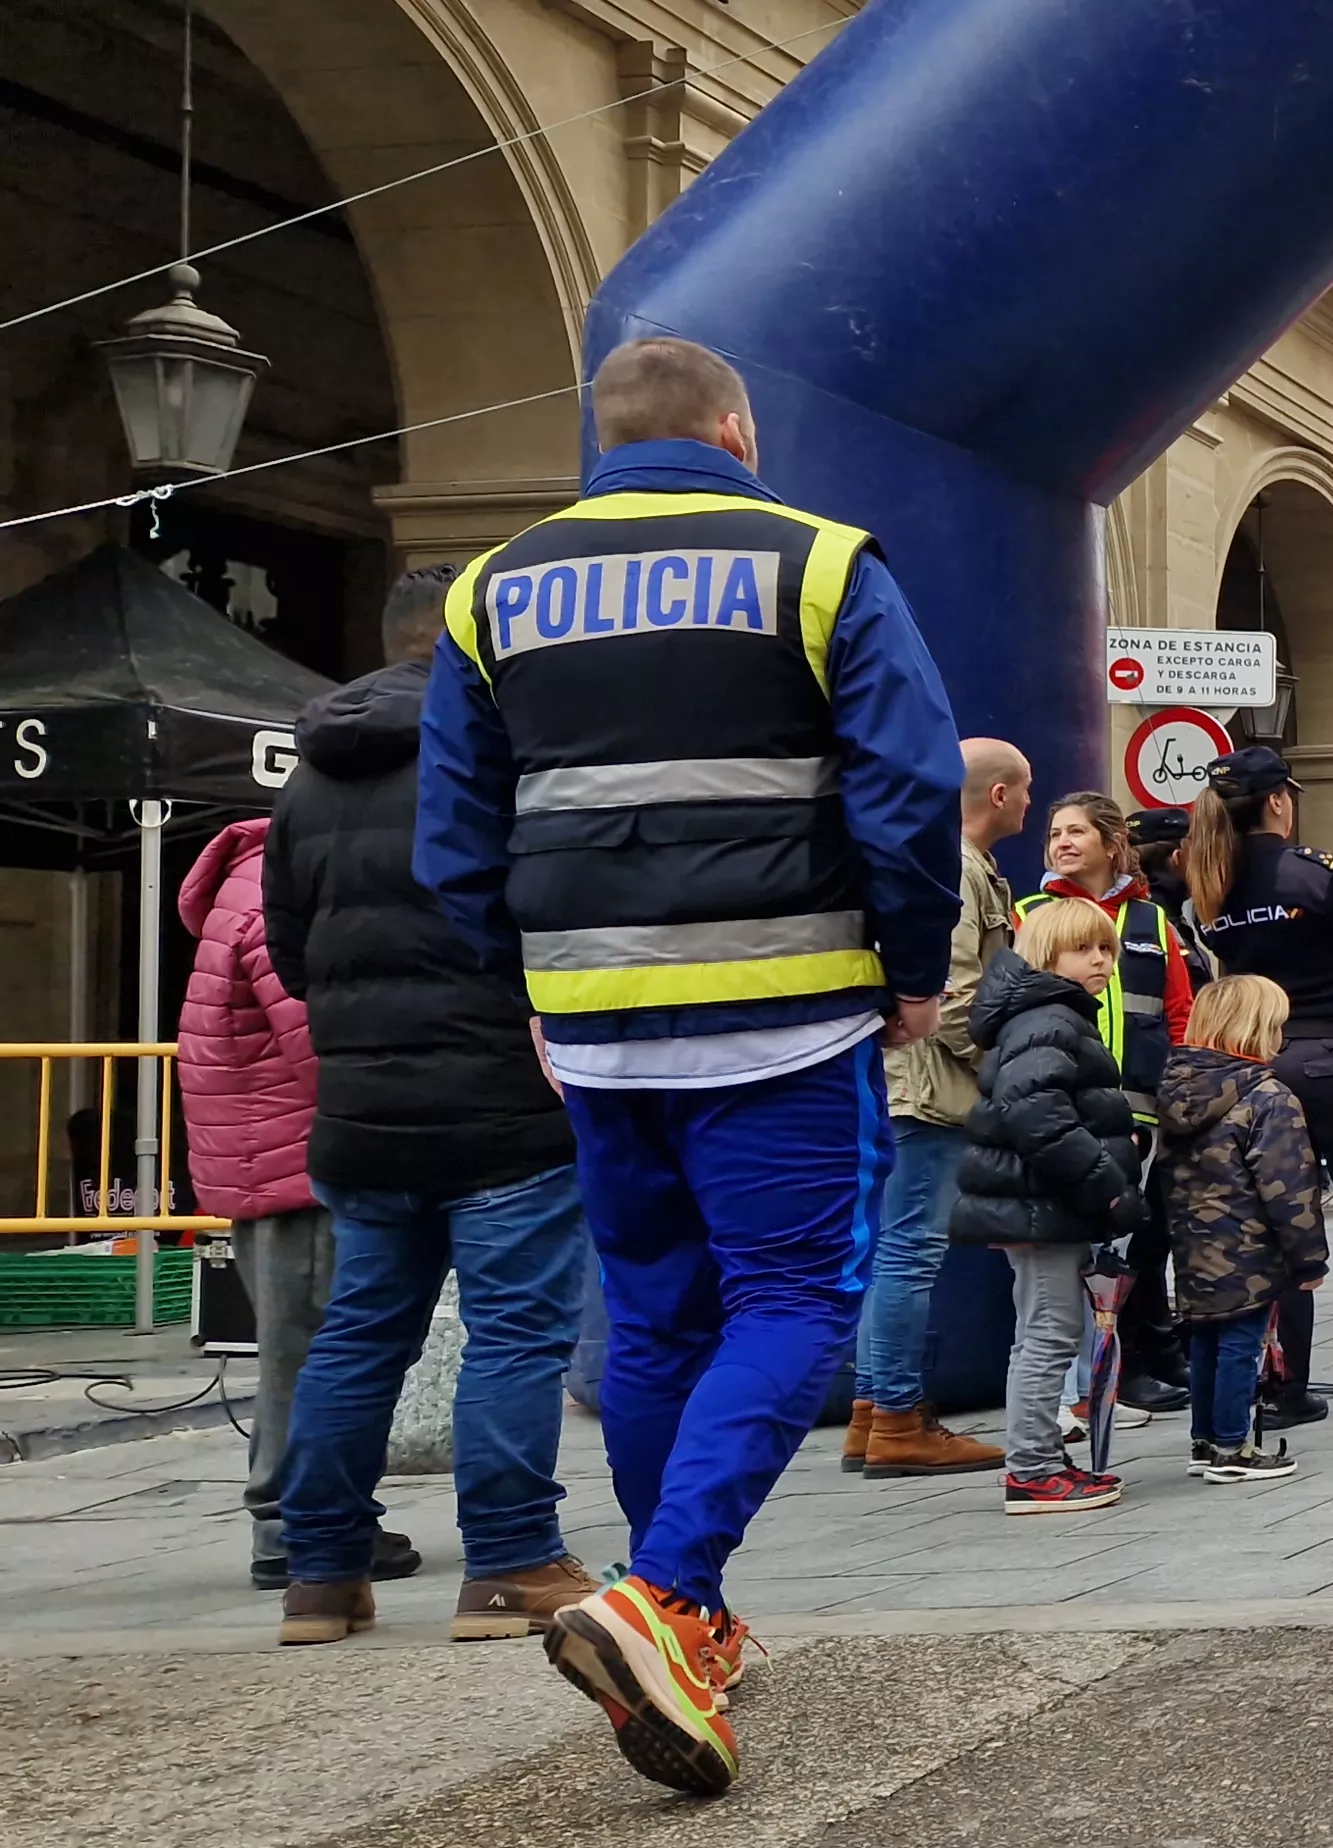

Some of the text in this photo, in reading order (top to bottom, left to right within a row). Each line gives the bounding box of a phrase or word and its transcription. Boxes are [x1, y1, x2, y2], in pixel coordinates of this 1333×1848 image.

[496, 556, 764, 650] POLICIA
[1109, 638, 1262, 654] ZONA DE ESTANCIA
[1157, 656, 1261, 667] EXCEPTO CARGA
[1158, 670, 1236, 680] Y DESCARGA
[1156, 685, 1172, 694] DE
[1188, 686, 1196, 694] A
[1201, 686, 1210, 695] 11
[1213, 687, 1257, 696] HORAS
[1200, 905, 1290, 936] POLICIA
